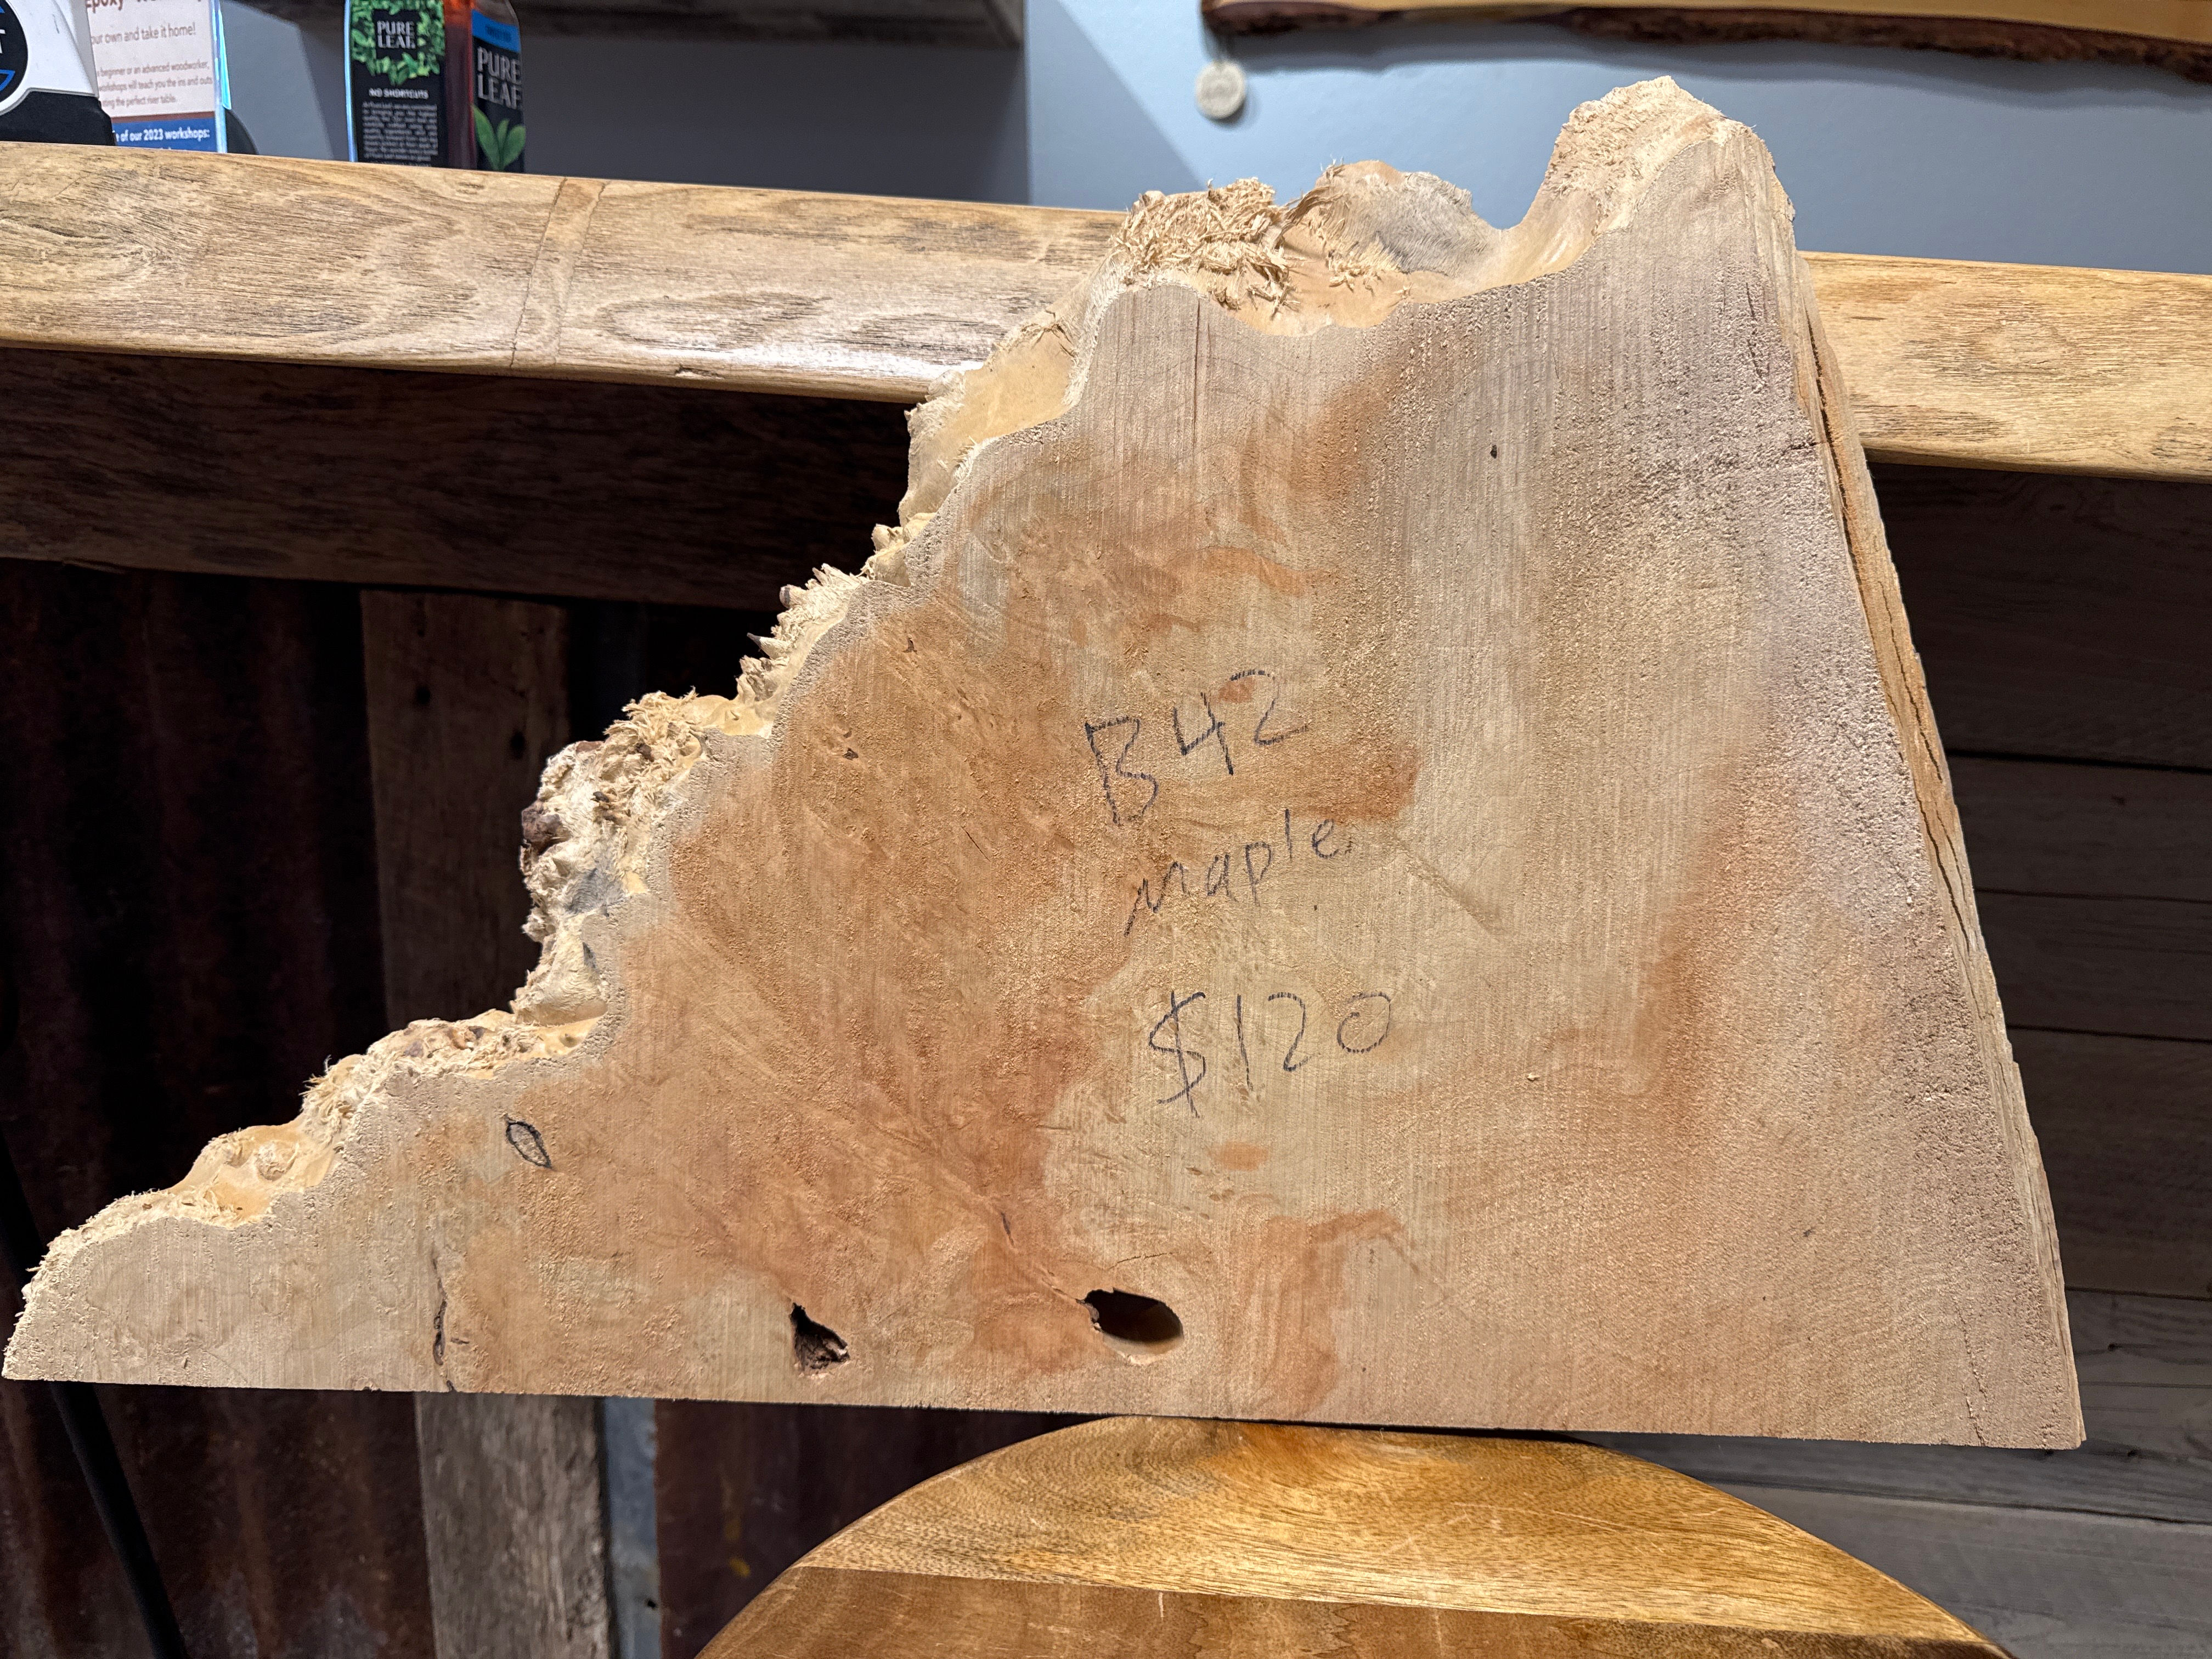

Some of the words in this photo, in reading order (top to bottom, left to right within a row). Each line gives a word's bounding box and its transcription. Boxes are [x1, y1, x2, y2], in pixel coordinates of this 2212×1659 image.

[105, 33, 122, 43] own
[124, 26, 139, 42] and
[141, 26, 158, 40] take
[160, 24, 167, 38] it
[167, 22, 196, 38] home!
[377, 20, 415, 36] PURE
[377, 35, 416, 49] LEAF
[477, 46, 521, 85] PURE
[369, 88, 383, 97] NO
[384, 88, 429, 99] SHORTCUTS
[477, 72, 521, 110] LEAF
[121, 129, 128, 142] of
[129, 132, 142, 142] our
[143, 128, 163, 140] 2023
[165, 127, 210, 142] workshops:
[1085, 669, 1310, 826] B42
[1148, 990, 1392, 1118] $120
